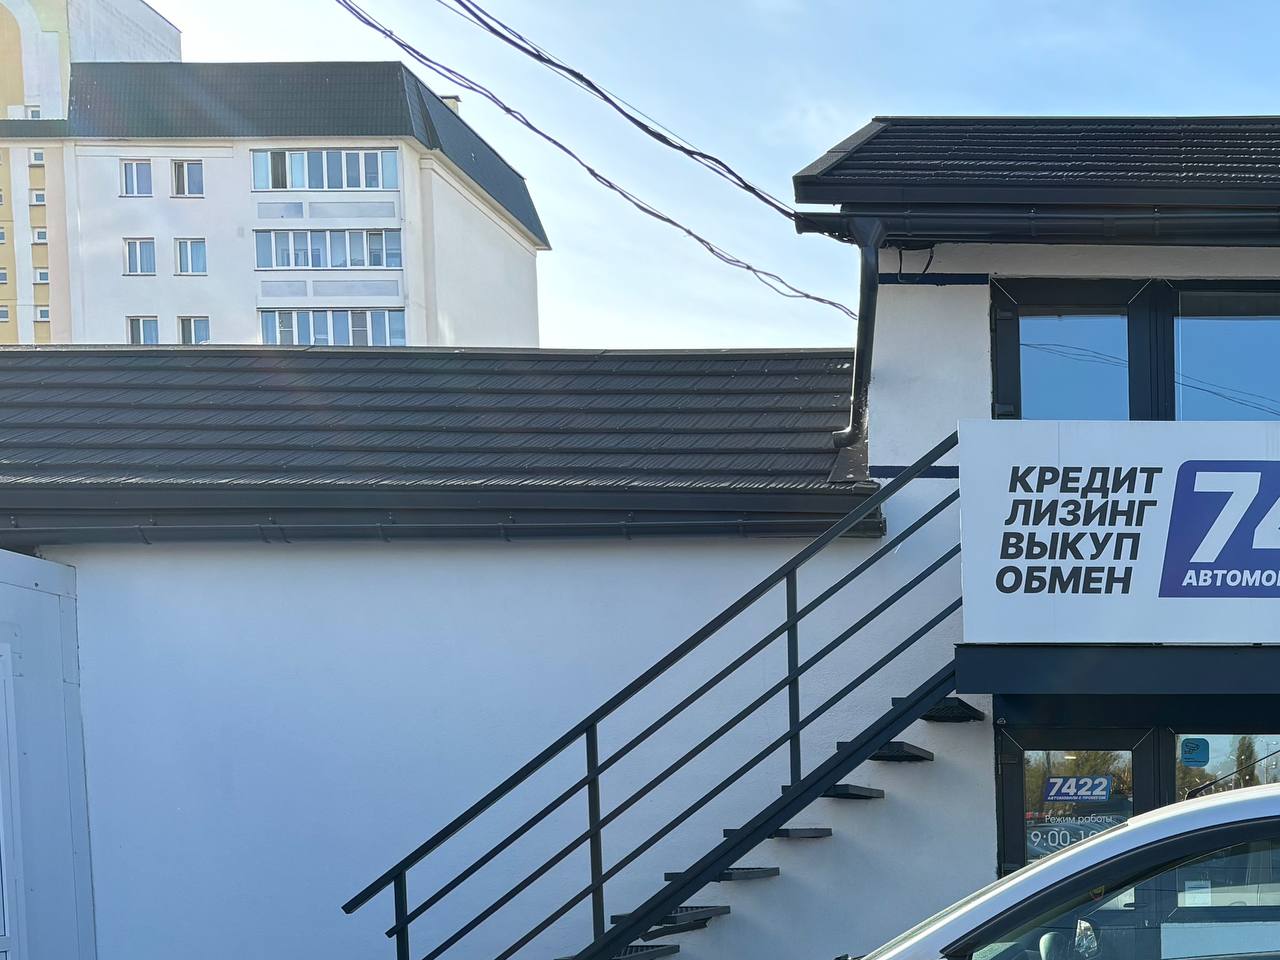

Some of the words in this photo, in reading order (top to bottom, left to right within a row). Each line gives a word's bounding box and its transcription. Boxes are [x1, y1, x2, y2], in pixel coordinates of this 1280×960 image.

[1008, 466, 1162, 498] КРЕДИТ
[1004, 500, 1158, 527] ЛИЗИНГ
[999, 532, 1140, 560] ВЫКУП
[994, 565, 1132, 594] ОБМЕН
[1048, 778, 1108, 796] 7422
[1045, 815, 1075, 823] Режим
[1078, 813, 1113, 824] работы
